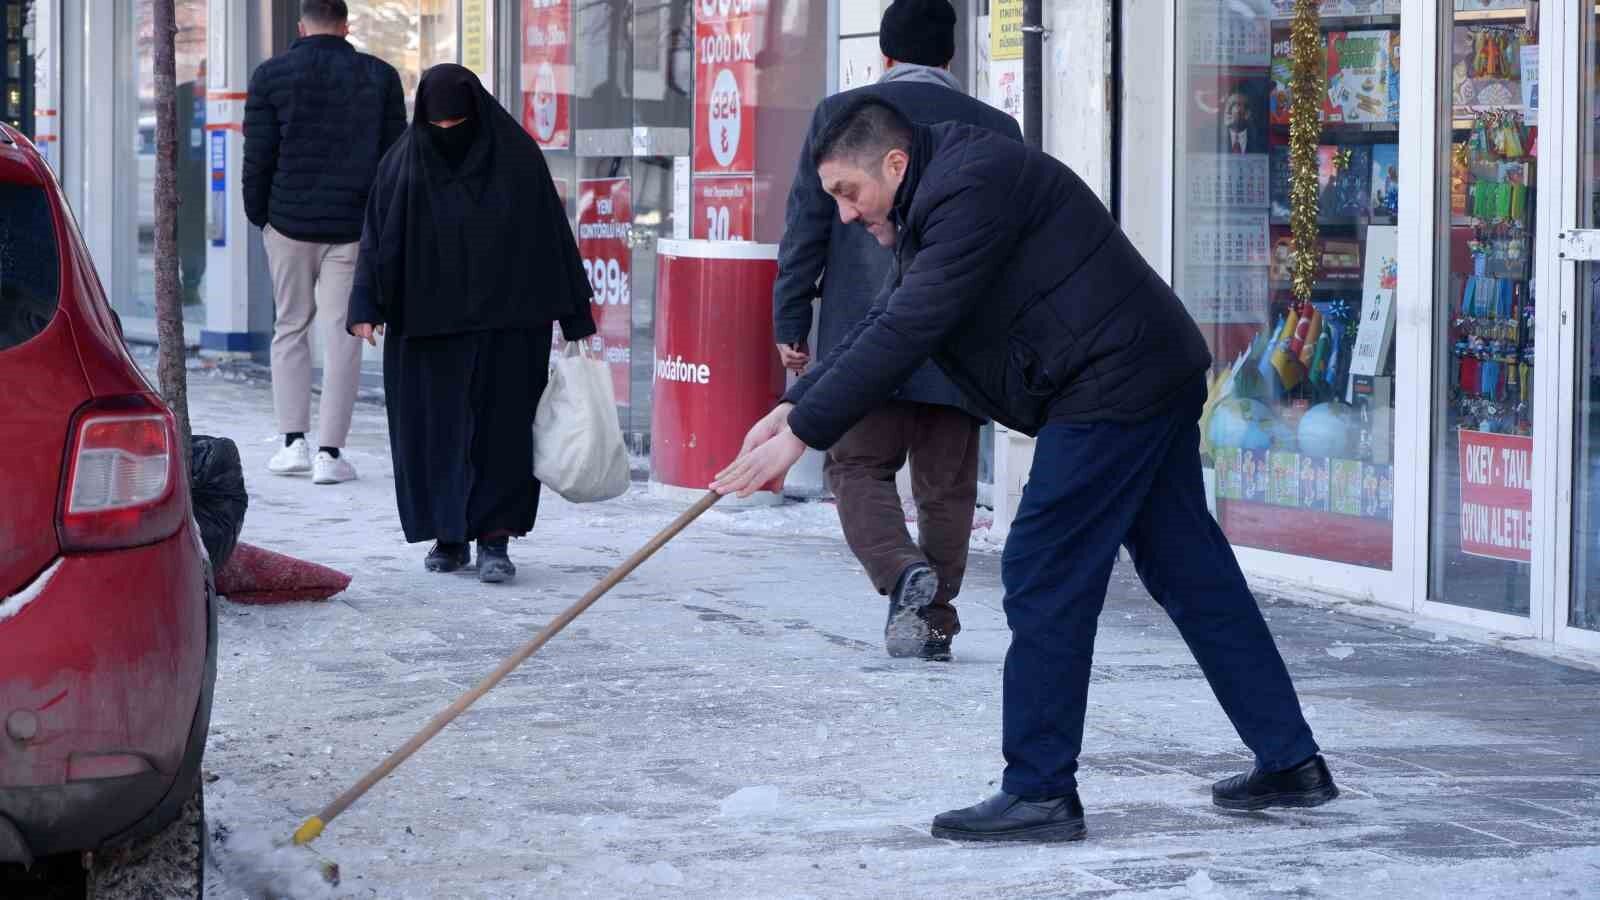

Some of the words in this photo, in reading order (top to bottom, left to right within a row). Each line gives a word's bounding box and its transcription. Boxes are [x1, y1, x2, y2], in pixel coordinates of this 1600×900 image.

[701, 33, 730, 64] 1000
[735, 31, 752, 61] DK
[712, 92, 737, 119] 324
[1465, 443, 1494, 485] OKEY
[1462, 502, 1488, 545] OYUN
